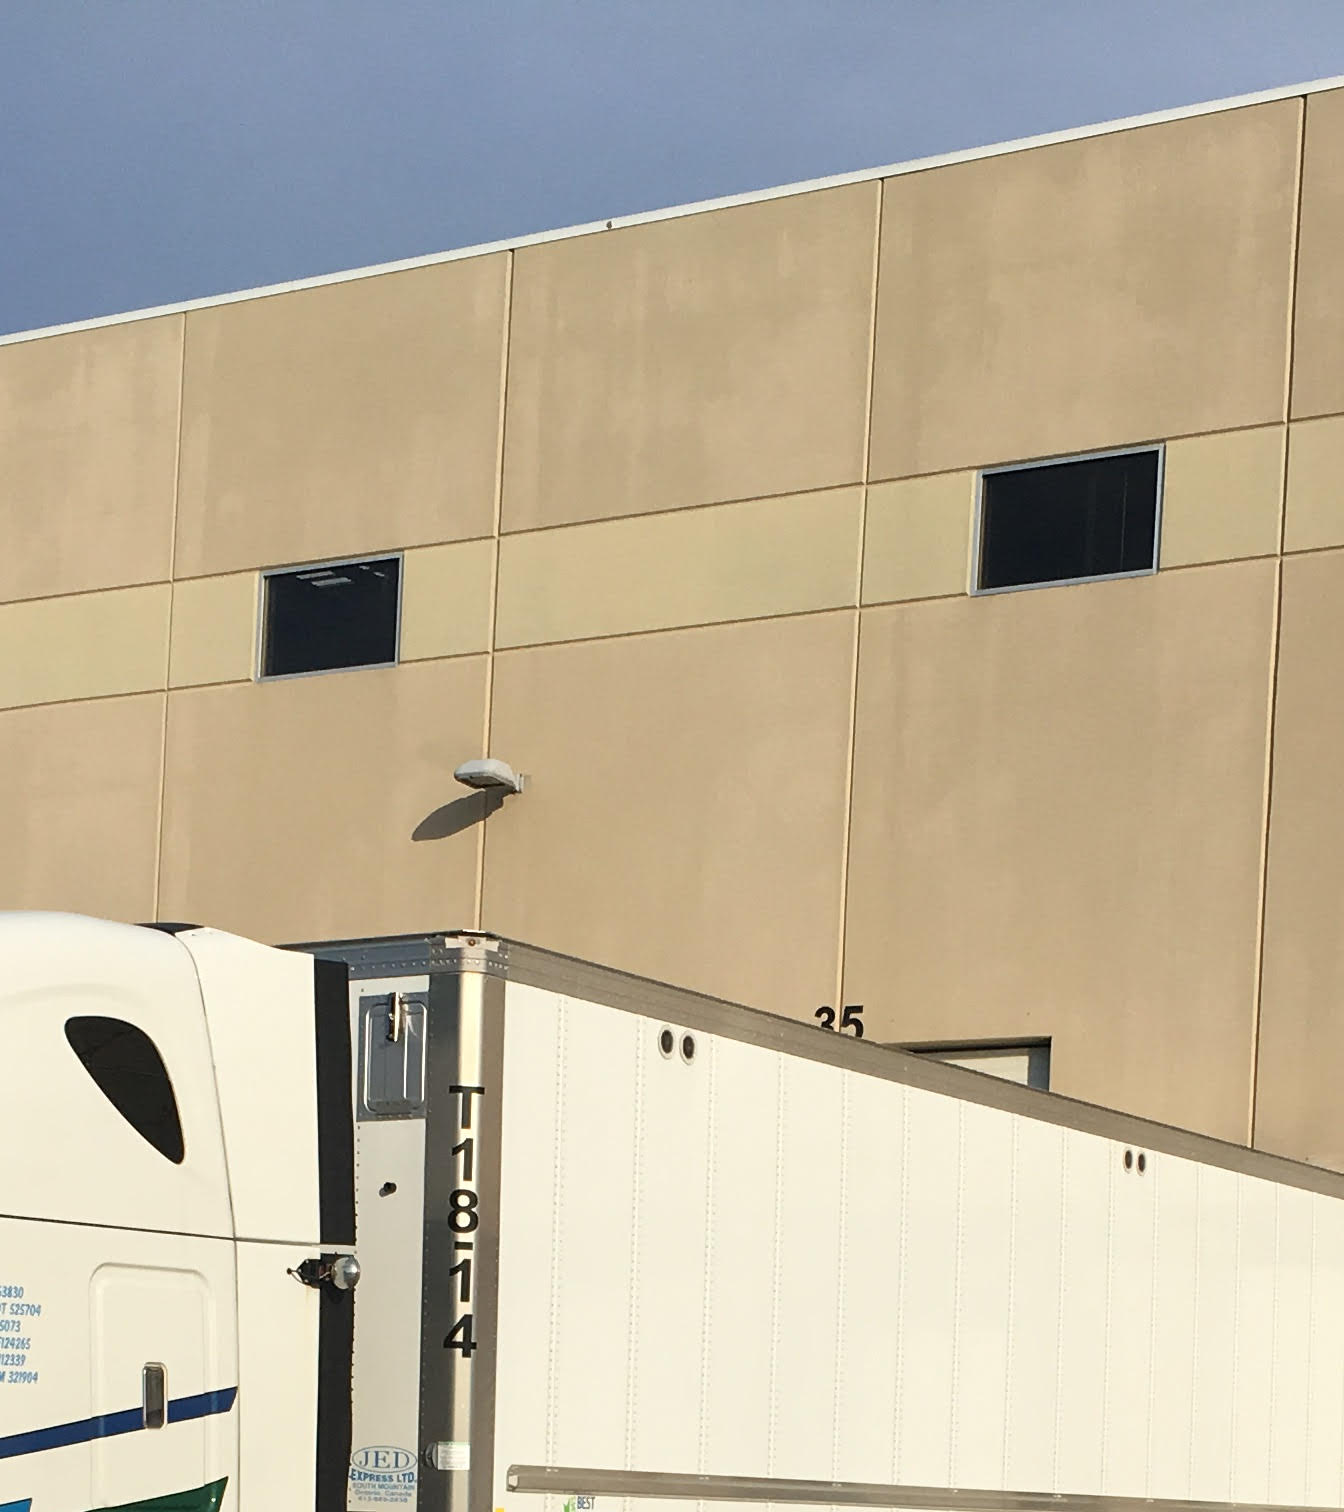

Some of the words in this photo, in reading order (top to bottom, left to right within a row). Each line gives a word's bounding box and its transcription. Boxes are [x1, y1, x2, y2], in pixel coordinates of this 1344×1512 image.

[814, 1005, 864, 1038] 35
[359, 1450, 409, 1469] JED
[350, 1468, 394, 1483] EXPRESS
[577, 1496, 596, 1510] BEST
